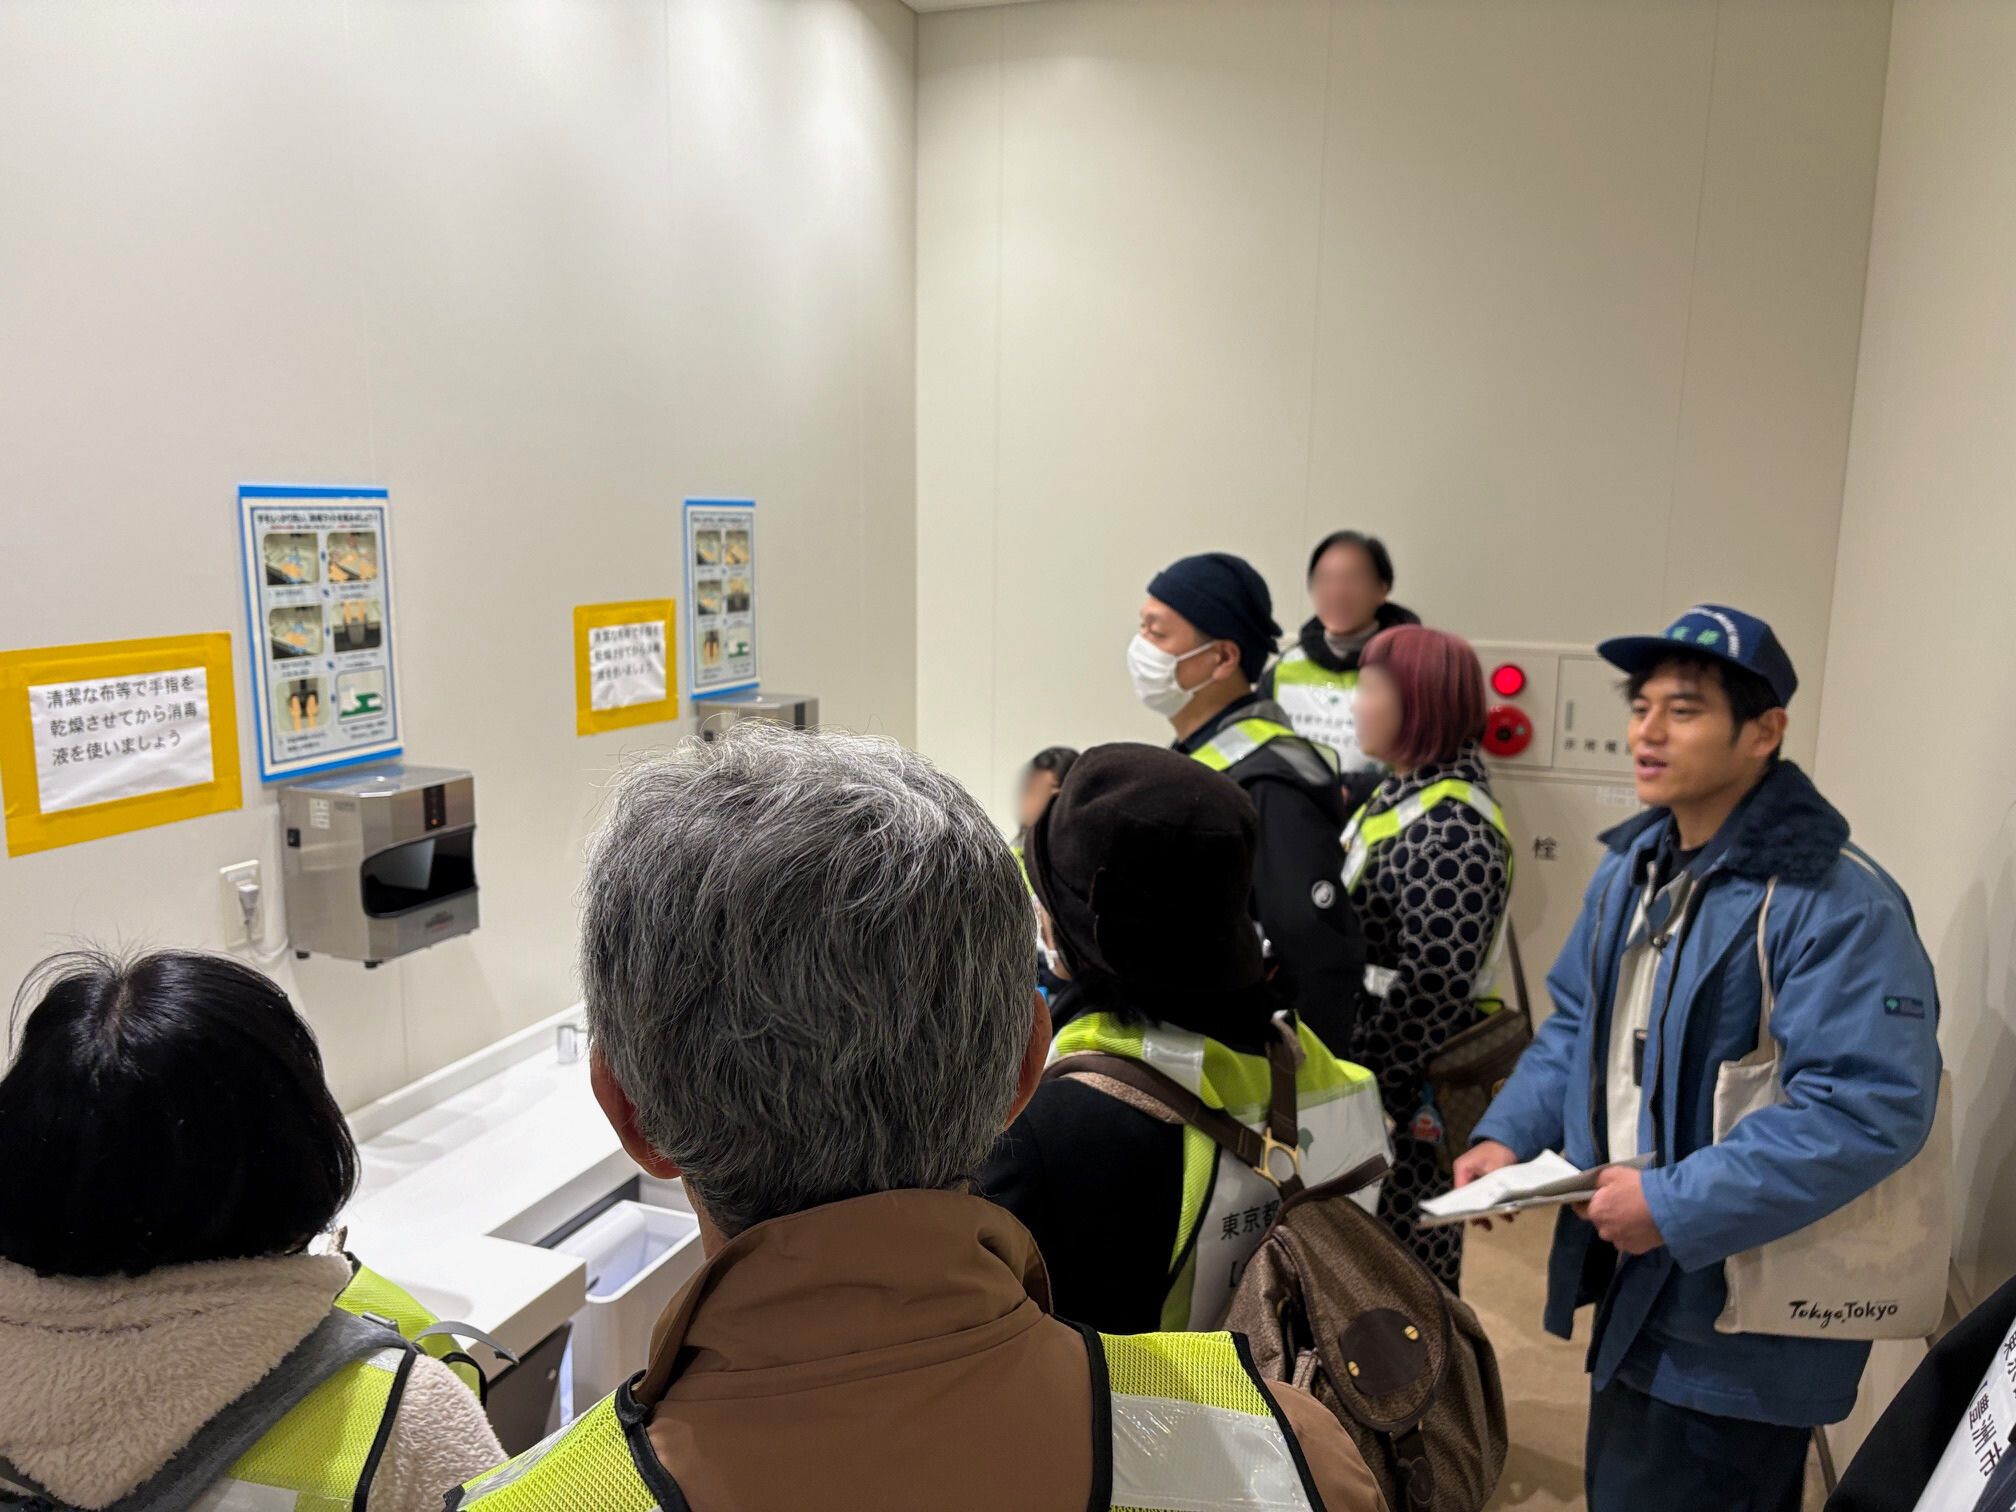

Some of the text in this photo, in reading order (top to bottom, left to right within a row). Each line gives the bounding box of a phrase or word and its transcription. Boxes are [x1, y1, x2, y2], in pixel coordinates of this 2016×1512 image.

[46, 675, 195, 710] 清潔な布等で手指を
[50, 701, 198, 738] 乾燥させてから消毒
[52, 729, 182, 767] 液を使いましょう
[1844, 1301, 1898, 1322] Tokyo
